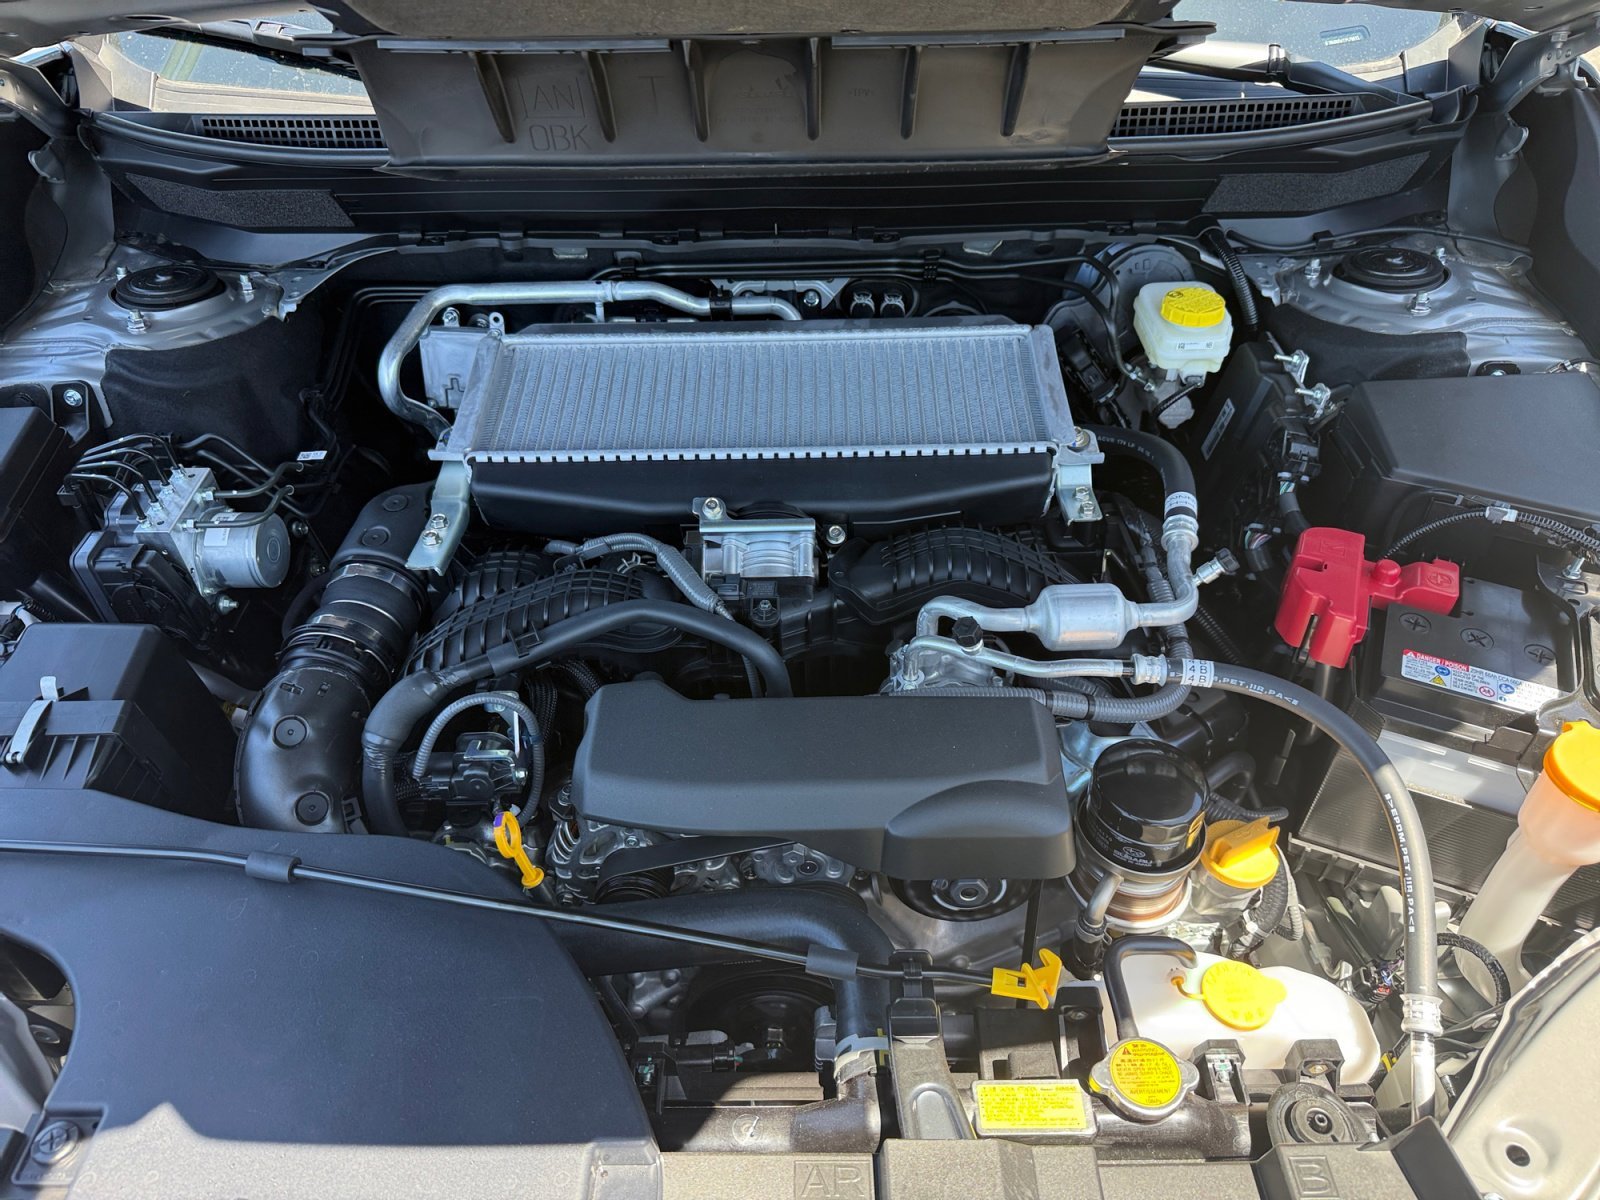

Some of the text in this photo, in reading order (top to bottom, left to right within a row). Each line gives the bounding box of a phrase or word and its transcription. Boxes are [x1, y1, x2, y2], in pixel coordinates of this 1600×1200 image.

[529, 124, 592, 151] OBK
[1416, 652, 1441, 665] DANGER
[1445, 661, 1468, 673] POISON
[1113, 849, 1153, 865] SUBARU
[800, 1164, 865, 1197] AR
[1294, 1161, 1331, 1195] B
